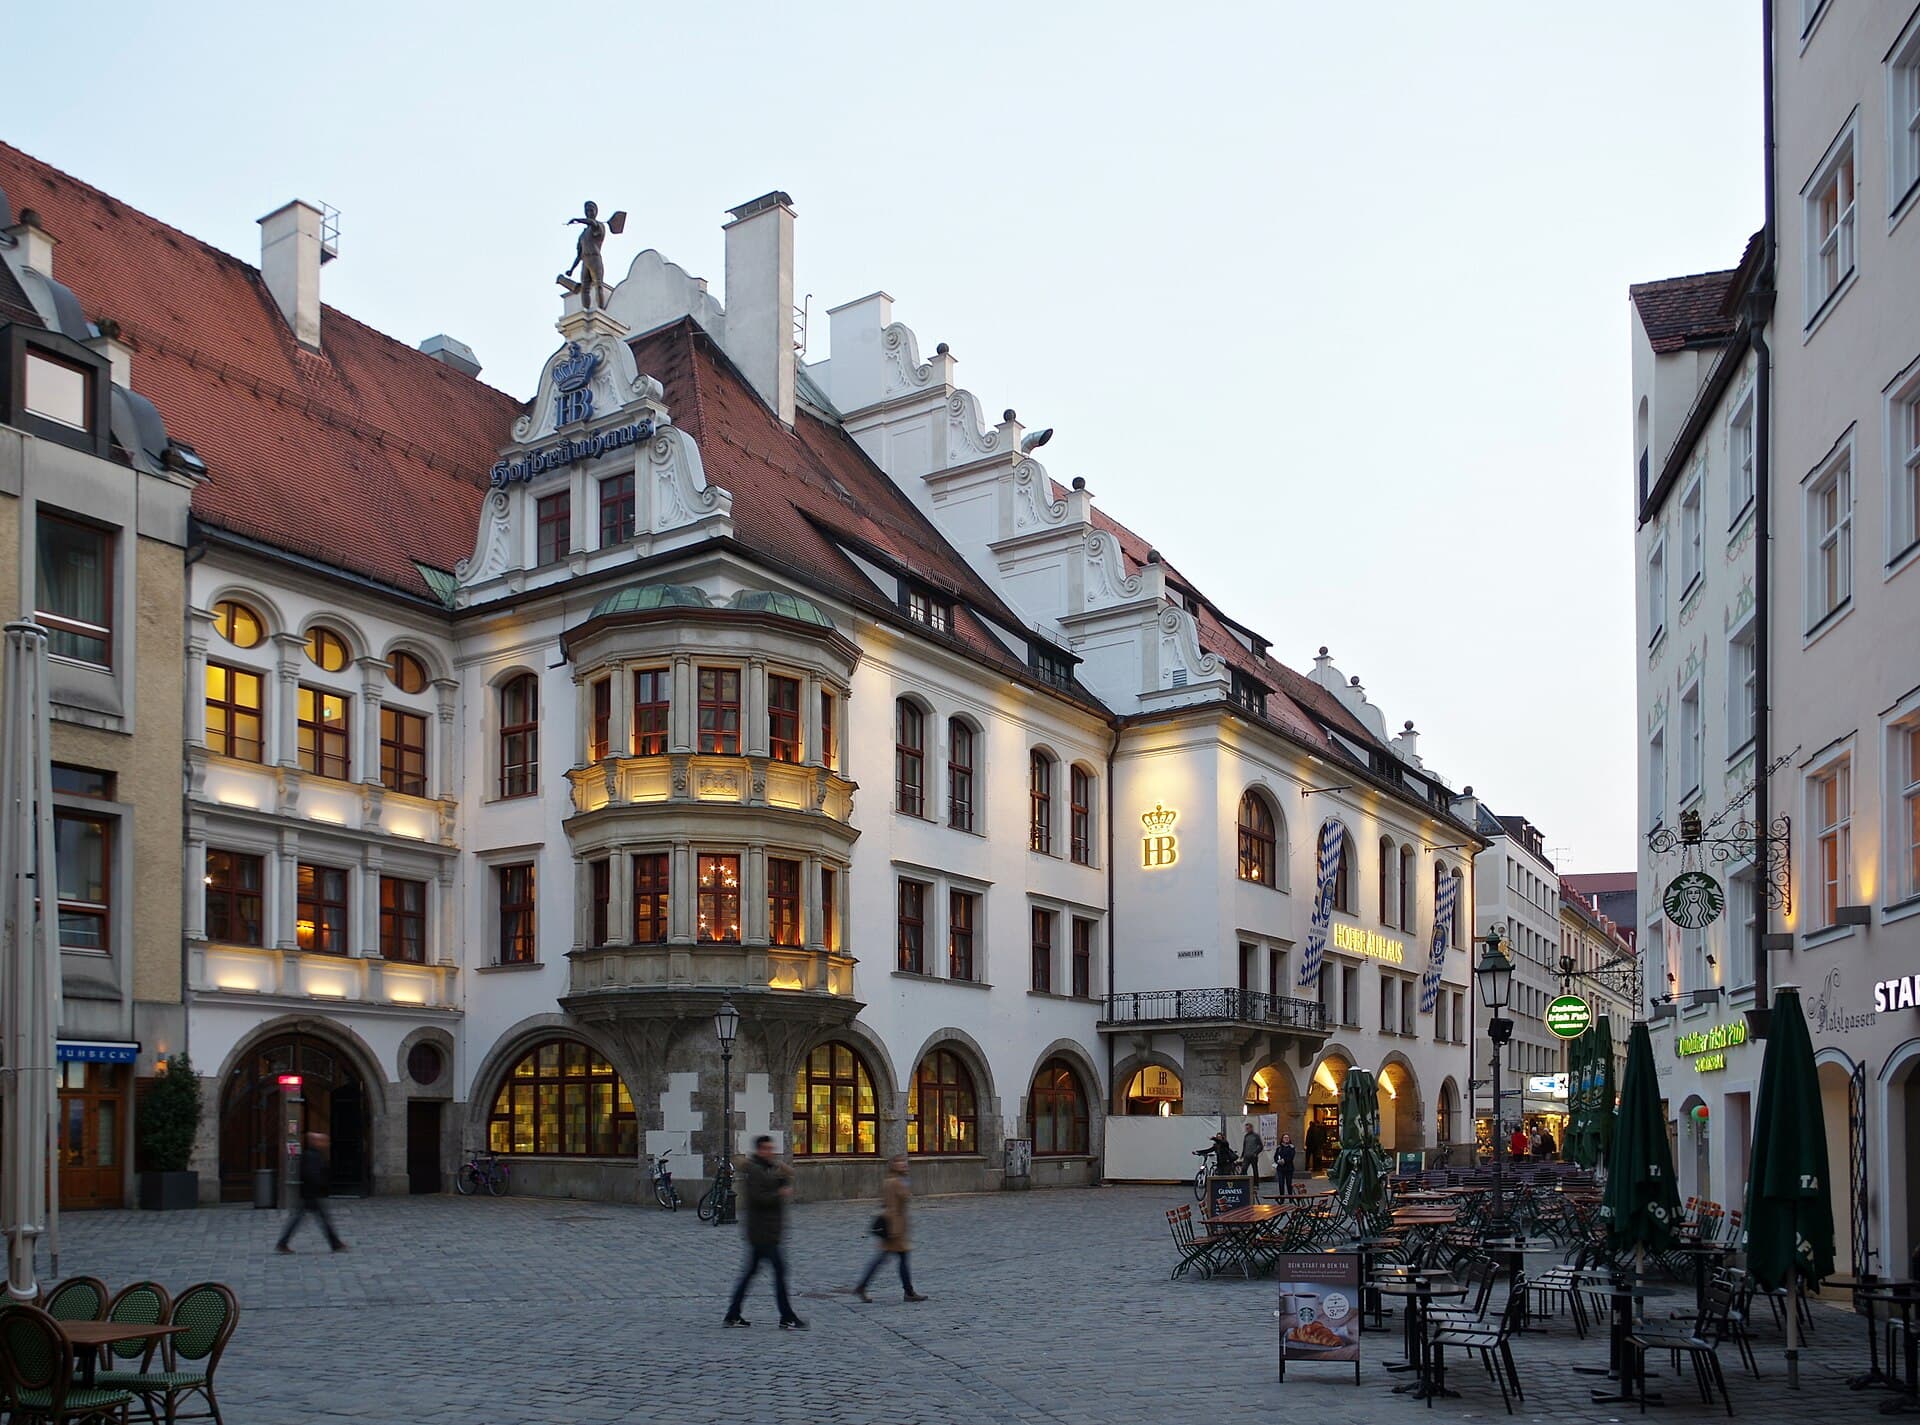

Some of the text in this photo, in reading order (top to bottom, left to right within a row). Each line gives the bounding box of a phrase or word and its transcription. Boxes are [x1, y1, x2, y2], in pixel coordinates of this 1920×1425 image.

[554, 387, 594, 431] HB
[489, 417, 656, 490] Hofbräuhaus
[1143, 836, 1177, 867] HB
[1334, 923, 1405, 965] HOFBRÄUHAUS
[1548, 1012, 1589, 1021] Irish Pub
[1552, 1005, 1586, 1013] Dubliner
[1679, 1031, 1709, 1056] Dubliner
[1727, 1019, 1746, 1046] Pub
